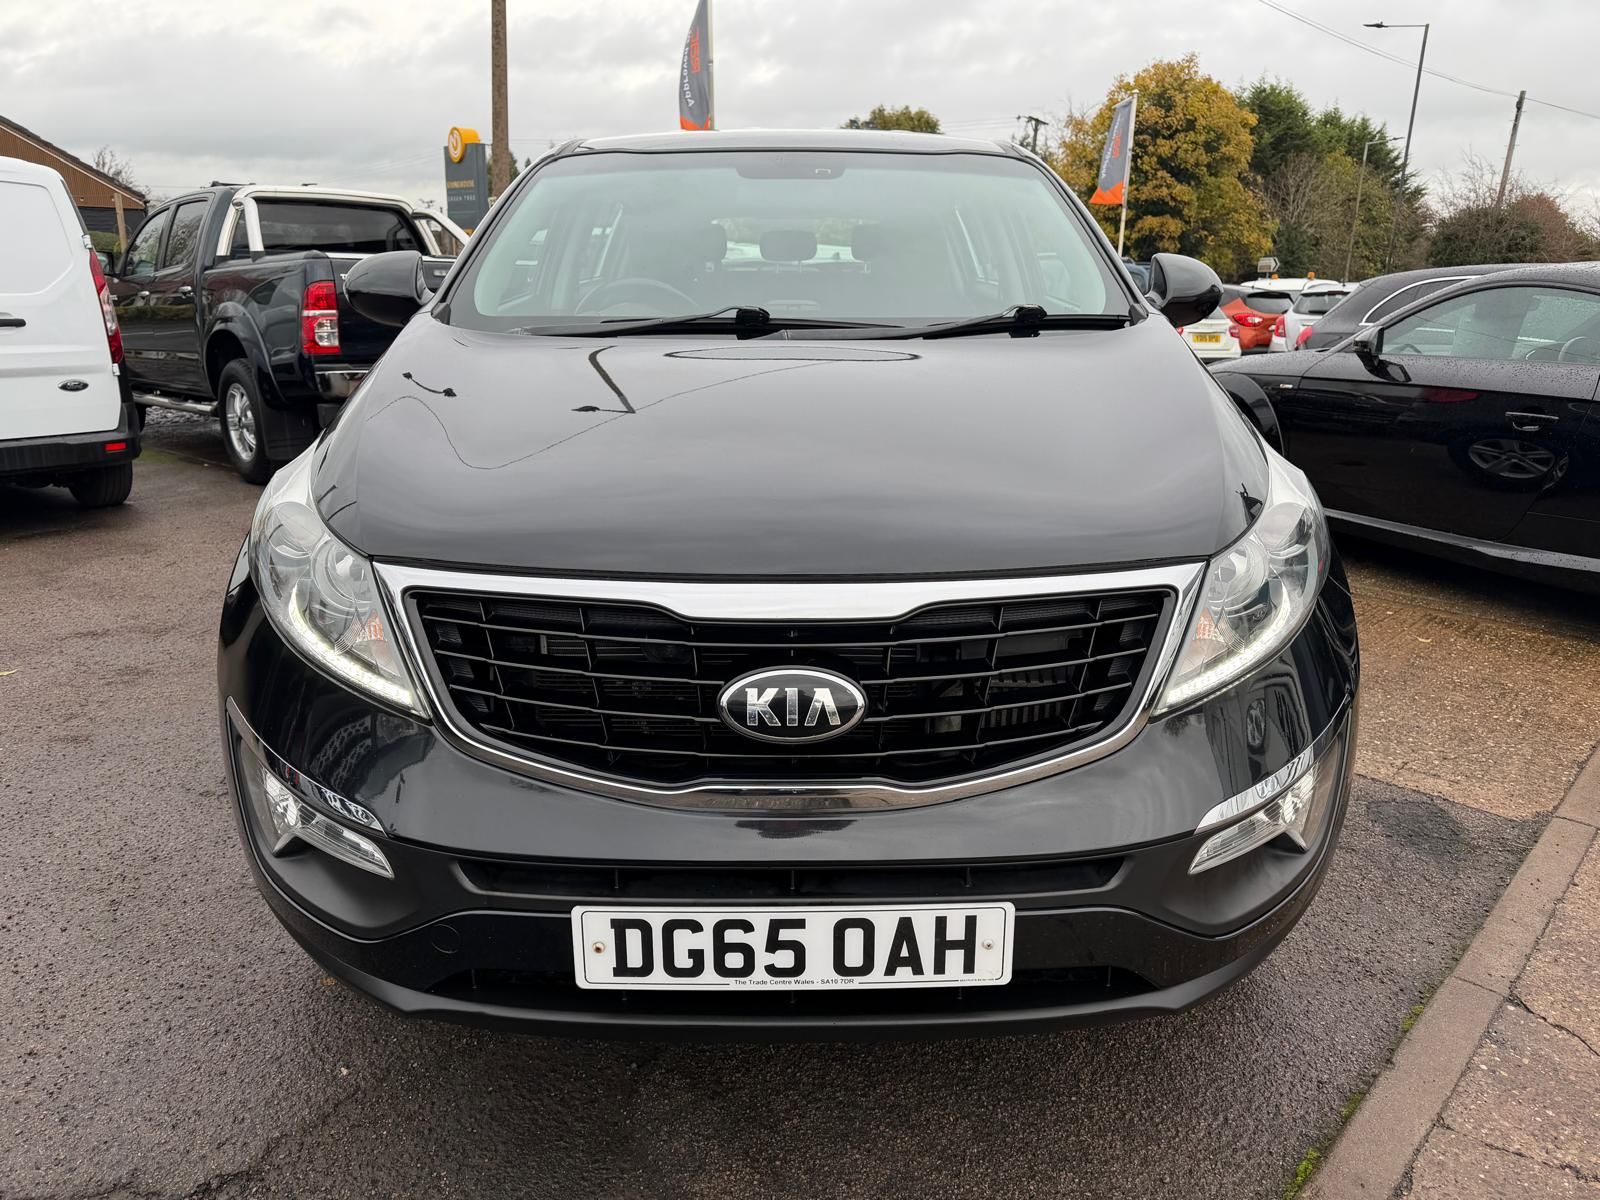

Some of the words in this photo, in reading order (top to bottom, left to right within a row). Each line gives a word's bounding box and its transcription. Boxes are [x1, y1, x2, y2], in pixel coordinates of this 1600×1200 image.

[745, 687, 841, 727] KIA
[610, 917, 806, 979] DG65
[832, 915, 977, 978] OAH
